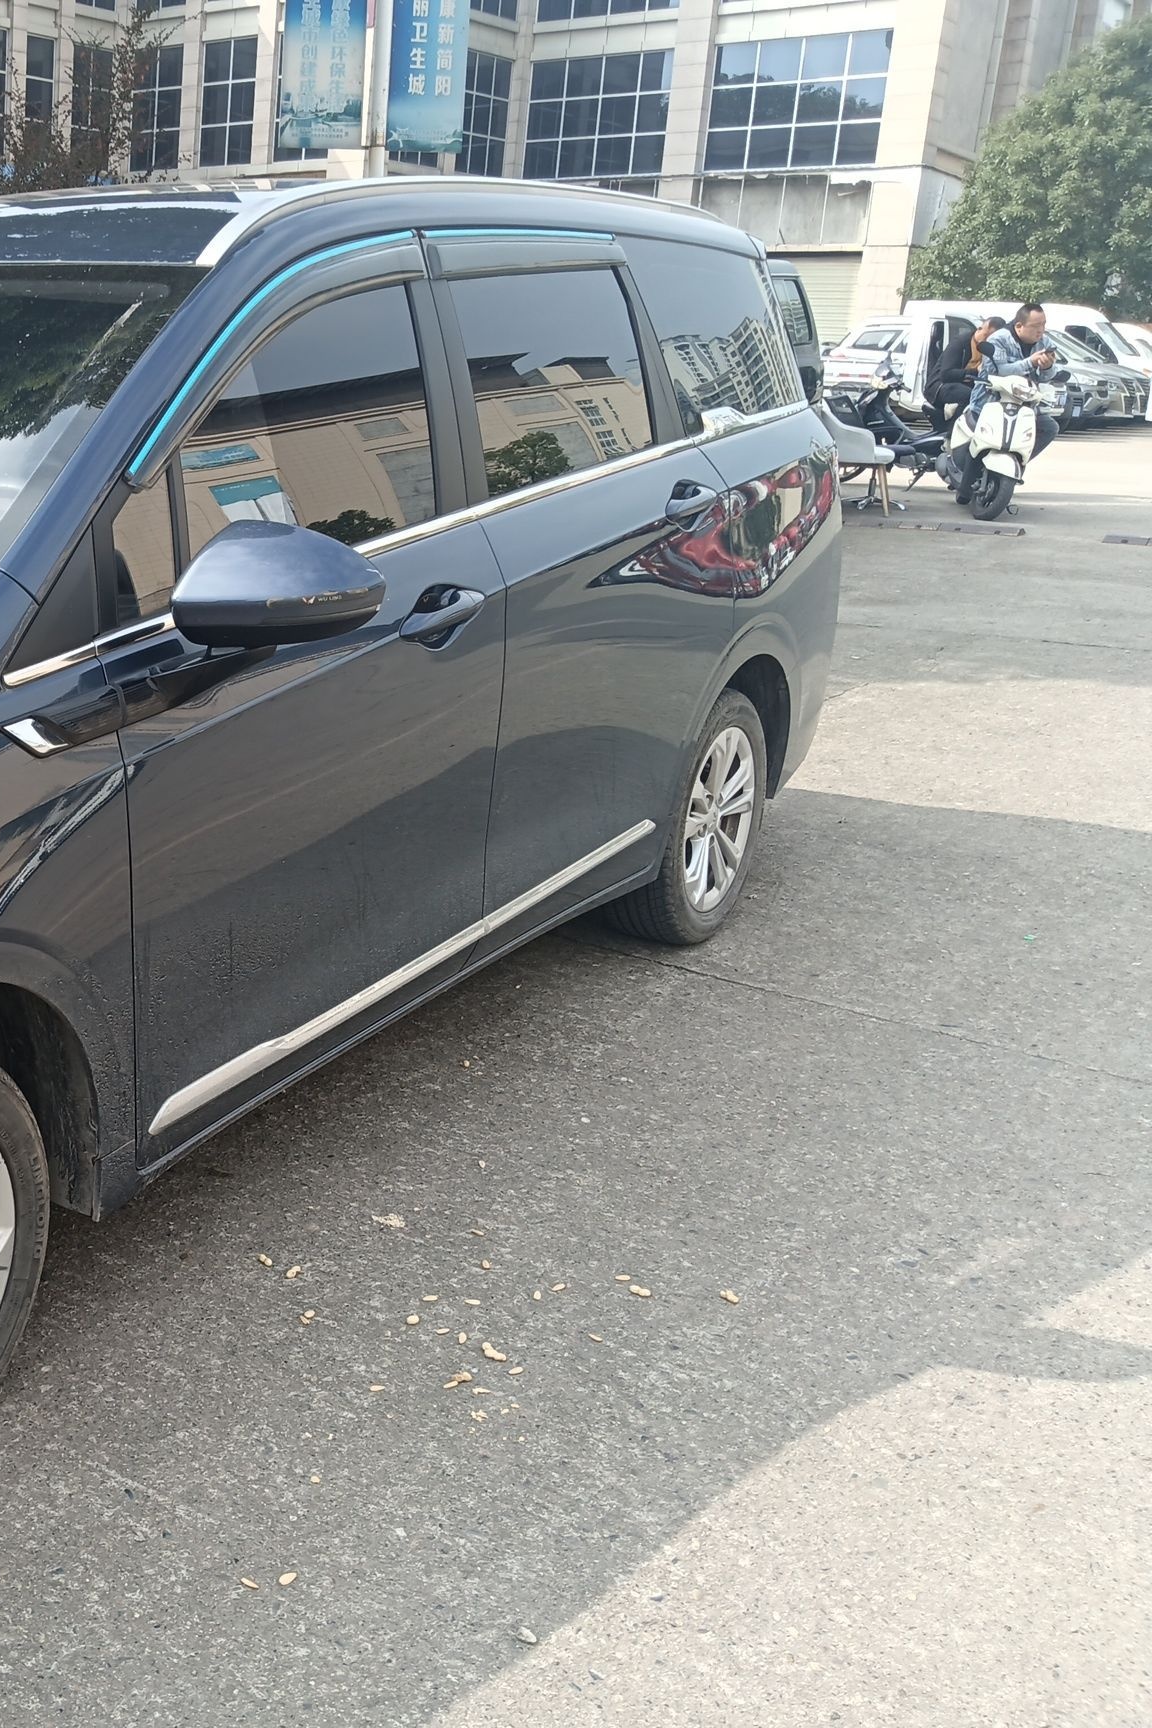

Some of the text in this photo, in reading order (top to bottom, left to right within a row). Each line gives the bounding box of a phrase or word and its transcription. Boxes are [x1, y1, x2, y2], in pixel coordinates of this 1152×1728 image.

[408, 0, 429, 95] 丽卫生城
[435, 0, 456, 96] 康新简阳
